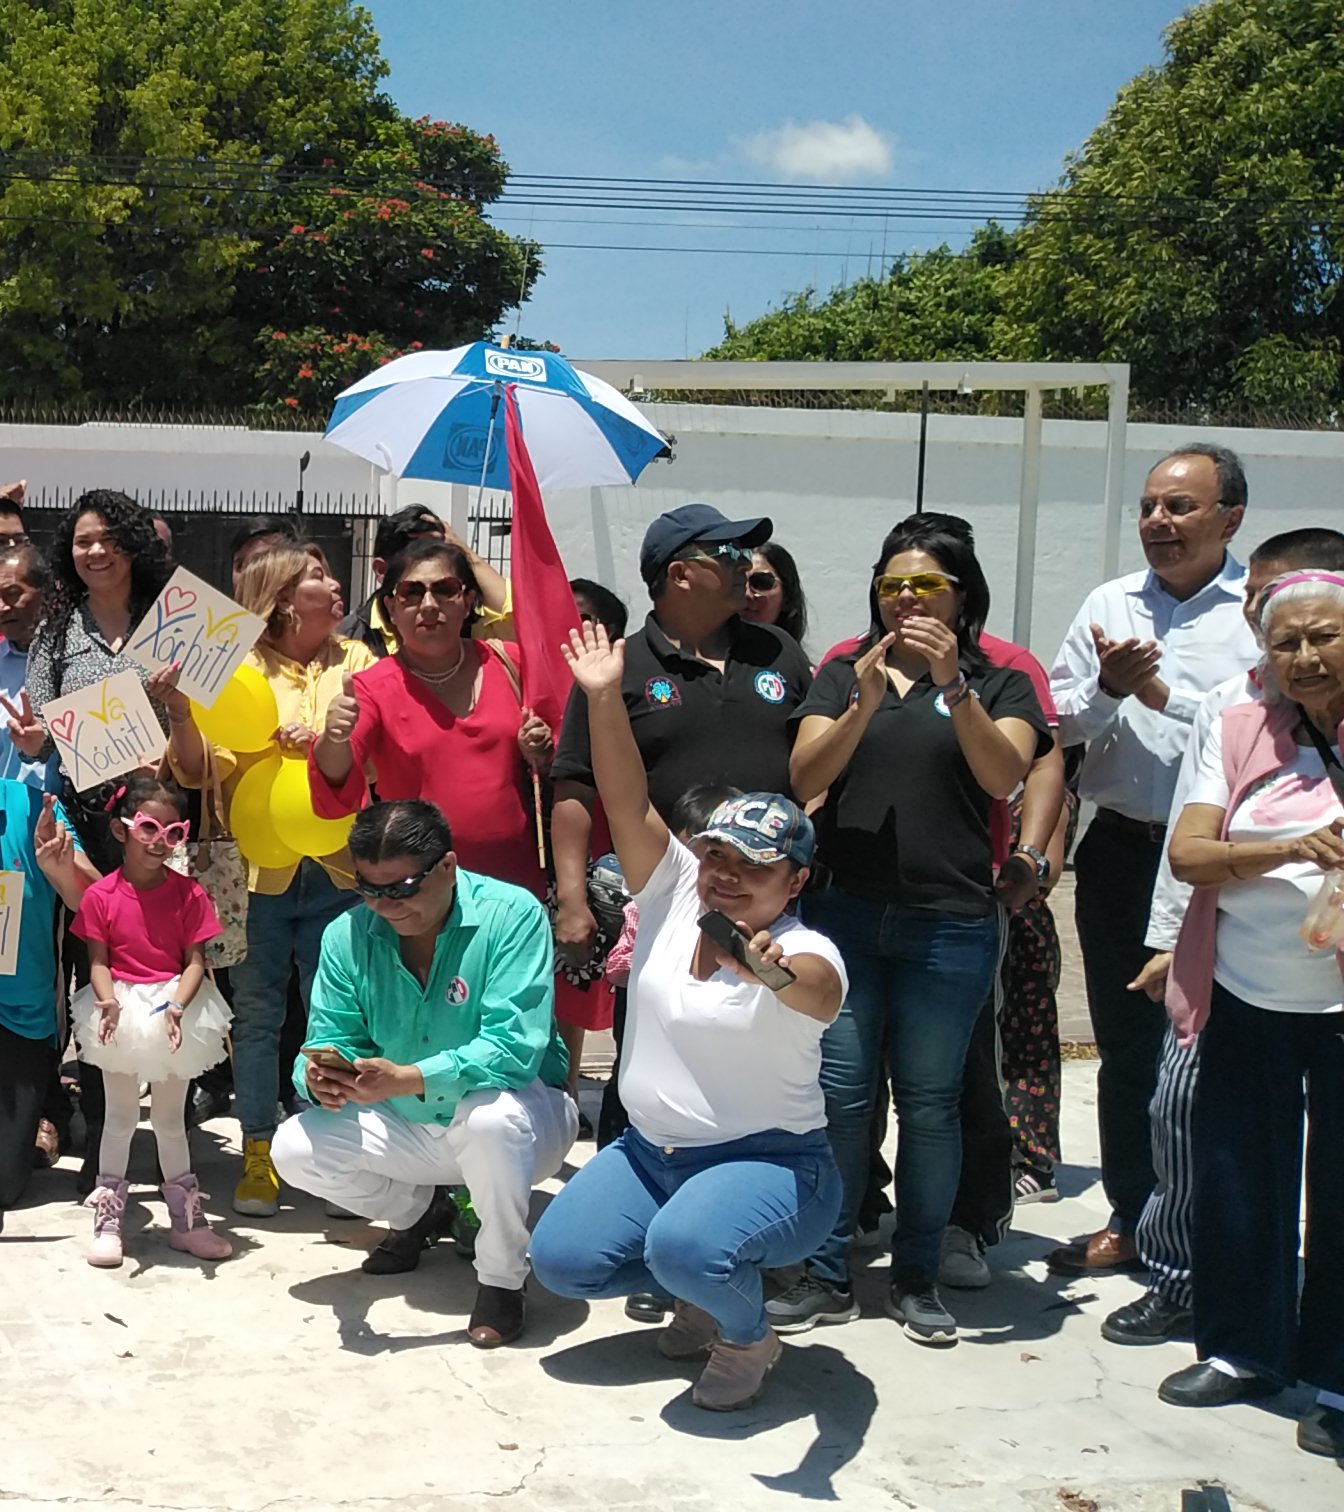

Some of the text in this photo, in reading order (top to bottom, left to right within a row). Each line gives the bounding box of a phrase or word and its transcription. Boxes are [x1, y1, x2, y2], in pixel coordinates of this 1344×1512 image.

[497, 356, 535, 373] PAN
[206, 606, 250, 644] Va
[88, 679, 126, 724] Va
[55, 709, 155, 787] Xóchitl
